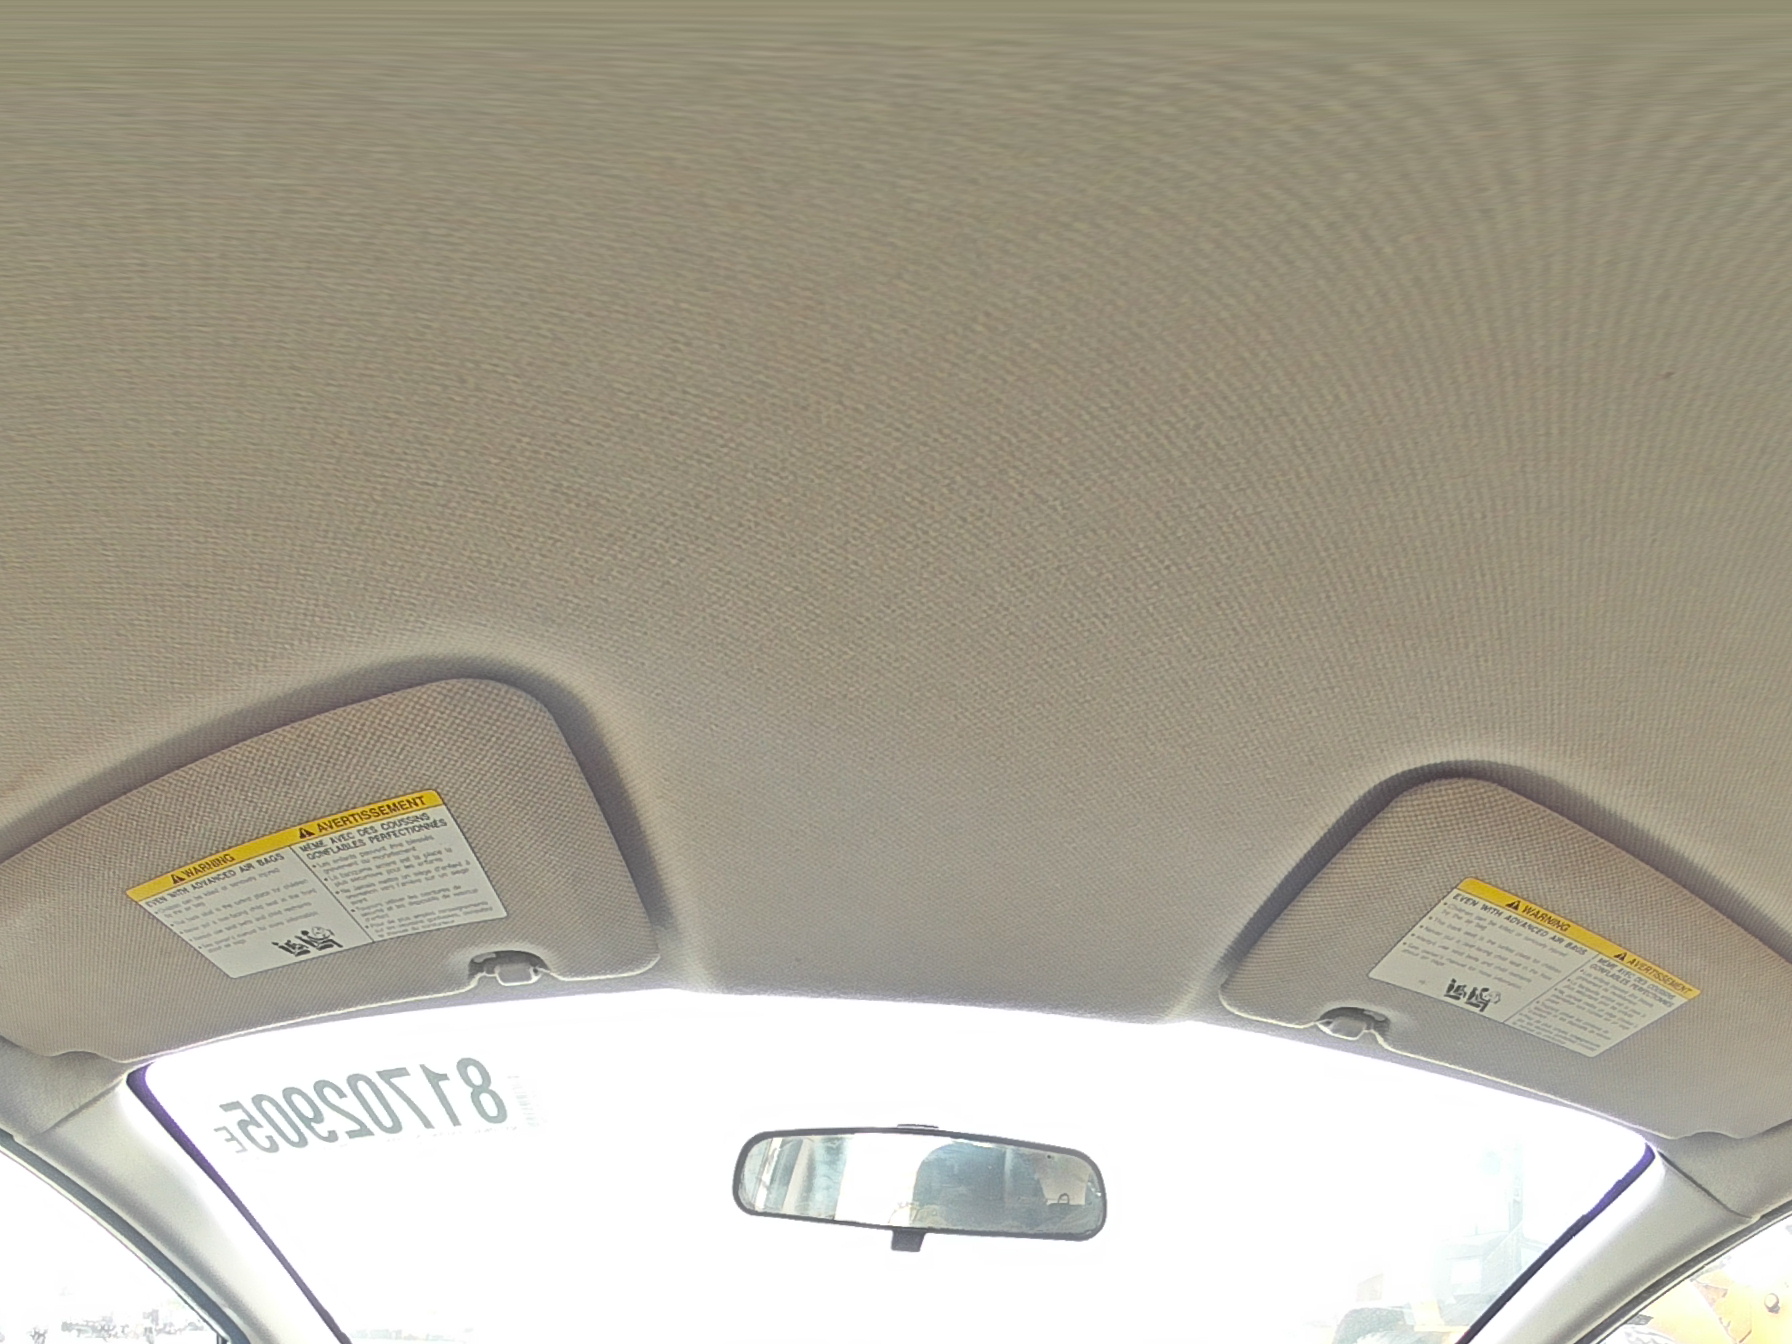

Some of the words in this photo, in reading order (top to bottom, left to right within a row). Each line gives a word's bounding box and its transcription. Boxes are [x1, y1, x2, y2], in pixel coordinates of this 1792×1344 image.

[317, 795, 426, 832] AVERTISSEMENT
[329, 832, 355, 844] AVEC
[357, 826, 378, 837] DES
[181, 853, 236, 878] WARNING
[191, 869, 237, 891] ADVANCED
[239, 862, 256, 874] AIR
[256, 853, 286, 867] BAGS
[1452, 893, 1479, 907] EVEN
[1480, 903, 1504, 918] WITH
[1504, 914, 1550, 938] ADVANCED
[1521, 904, 1572, 933] WARNING
[1626, 957, 1693, 994] AVERTISSEMENT
